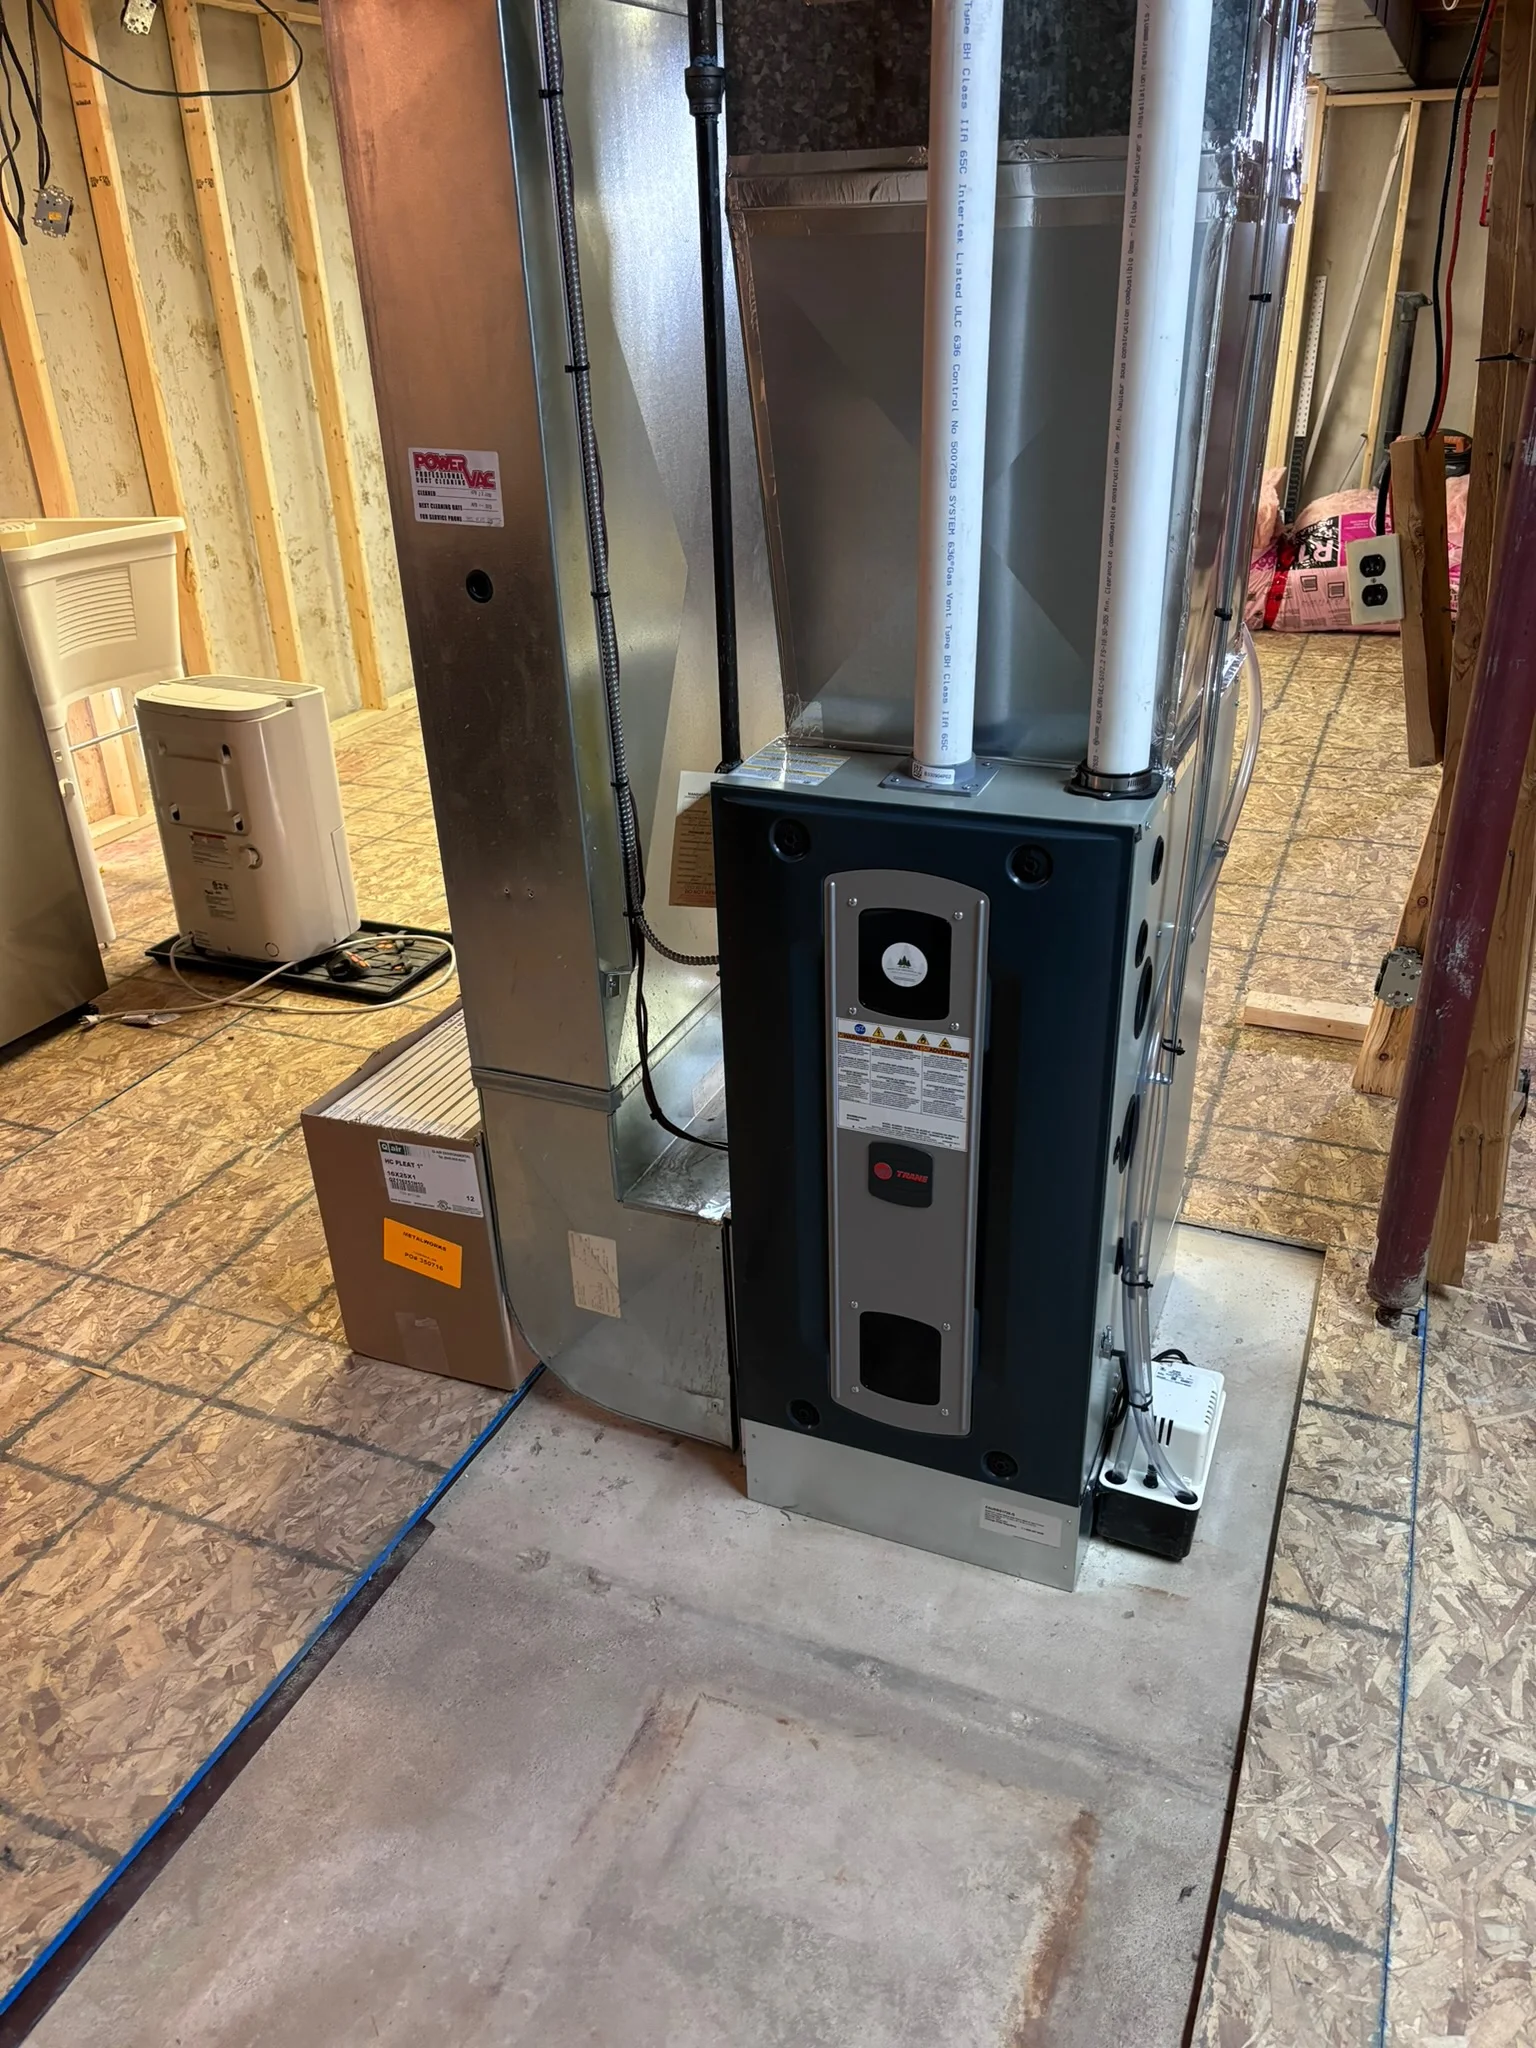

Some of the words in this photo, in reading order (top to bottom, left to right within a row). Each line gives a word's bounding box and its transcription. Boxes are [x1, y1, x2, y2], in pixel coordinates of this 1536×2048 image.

[963, 0, 974, 35] Type
[962, 42, 972, 60] BH
[960, 67, 972, 110] Class
[959, 118, 970, 143] IIA
[958, 149, 969, 175] 65C
[956, 182, 968, 244] Intertek
[954, 251, 965, 299] Listed
[953, 304, 963, 328] ULC
[952, 334, 962, 357] 636
[951, 363, 961, 412] Control
[950, 419, 959, 435] No
[413, 452, 468, 472] POWER
[948, 440, 959, 489] 5007693
[415, 471, 464, 480] PROFESSIONAL
[435, 478, 466, 486] CLEANING
[465, 470, 497, 490] VAC
[417, 489, 436, 497] CLEANED
[430, 503, 451, 511] CLEANING
[947, 494, 957, 536] SYSTEM
[1104, 561, 1113, 594] Clearance
[395, 1160, 415, 1168] PLEAT
[896, 1170, 929, 1184] TRANE
[403, 1231, 447, 1252] METALWORKS
